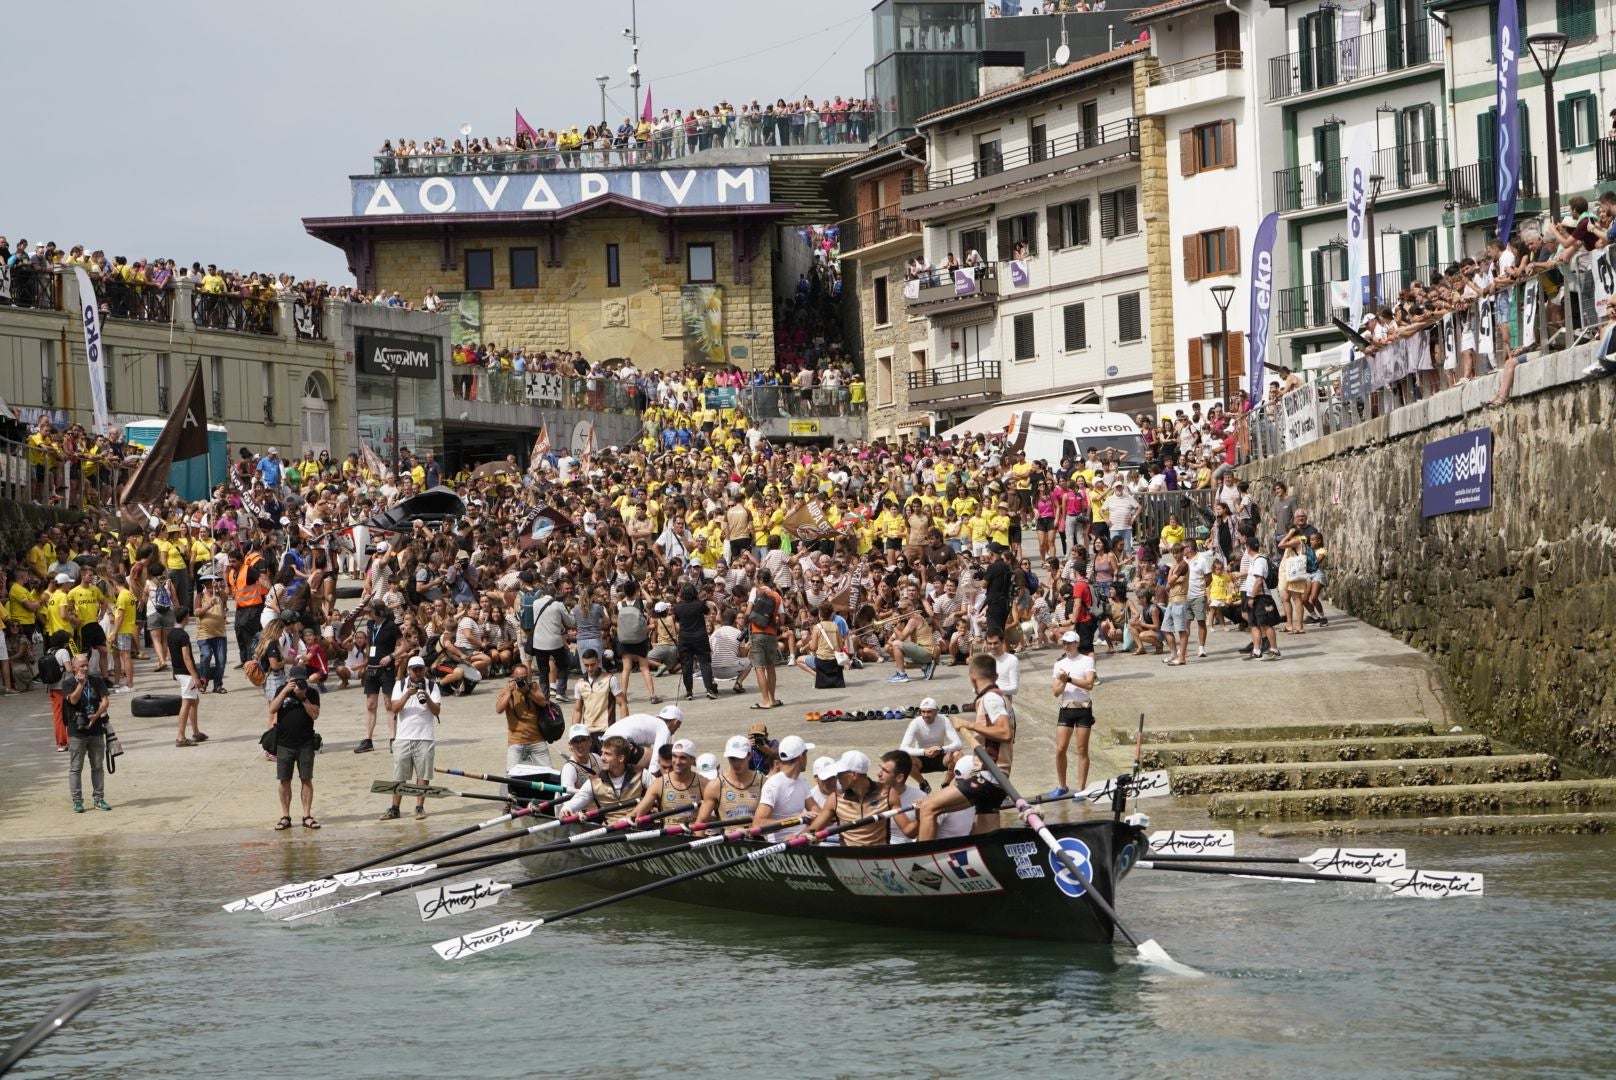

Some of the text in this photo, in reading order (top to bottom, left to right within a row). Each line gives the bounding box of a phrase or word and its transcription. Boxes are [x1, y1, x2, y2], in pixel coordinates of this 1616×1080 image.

[1254, 251, 1272, 310] ekp
[1081, 424, 1133, 434] overon
[1469, 436, 1487, 483] ekp
[1005, 841, 1038, 857] VIVEROS
[1014, 856, 1032, 866] SAN
[1313, 848, 1404, 875] Ameztoi
[1017, 866, 1044, 879] ANTON
[960, 879, 997, 892] BATELA
[1391, 870, 1482, 897] Ameztoi
[423, 879, 504, 920] Ameztoi
